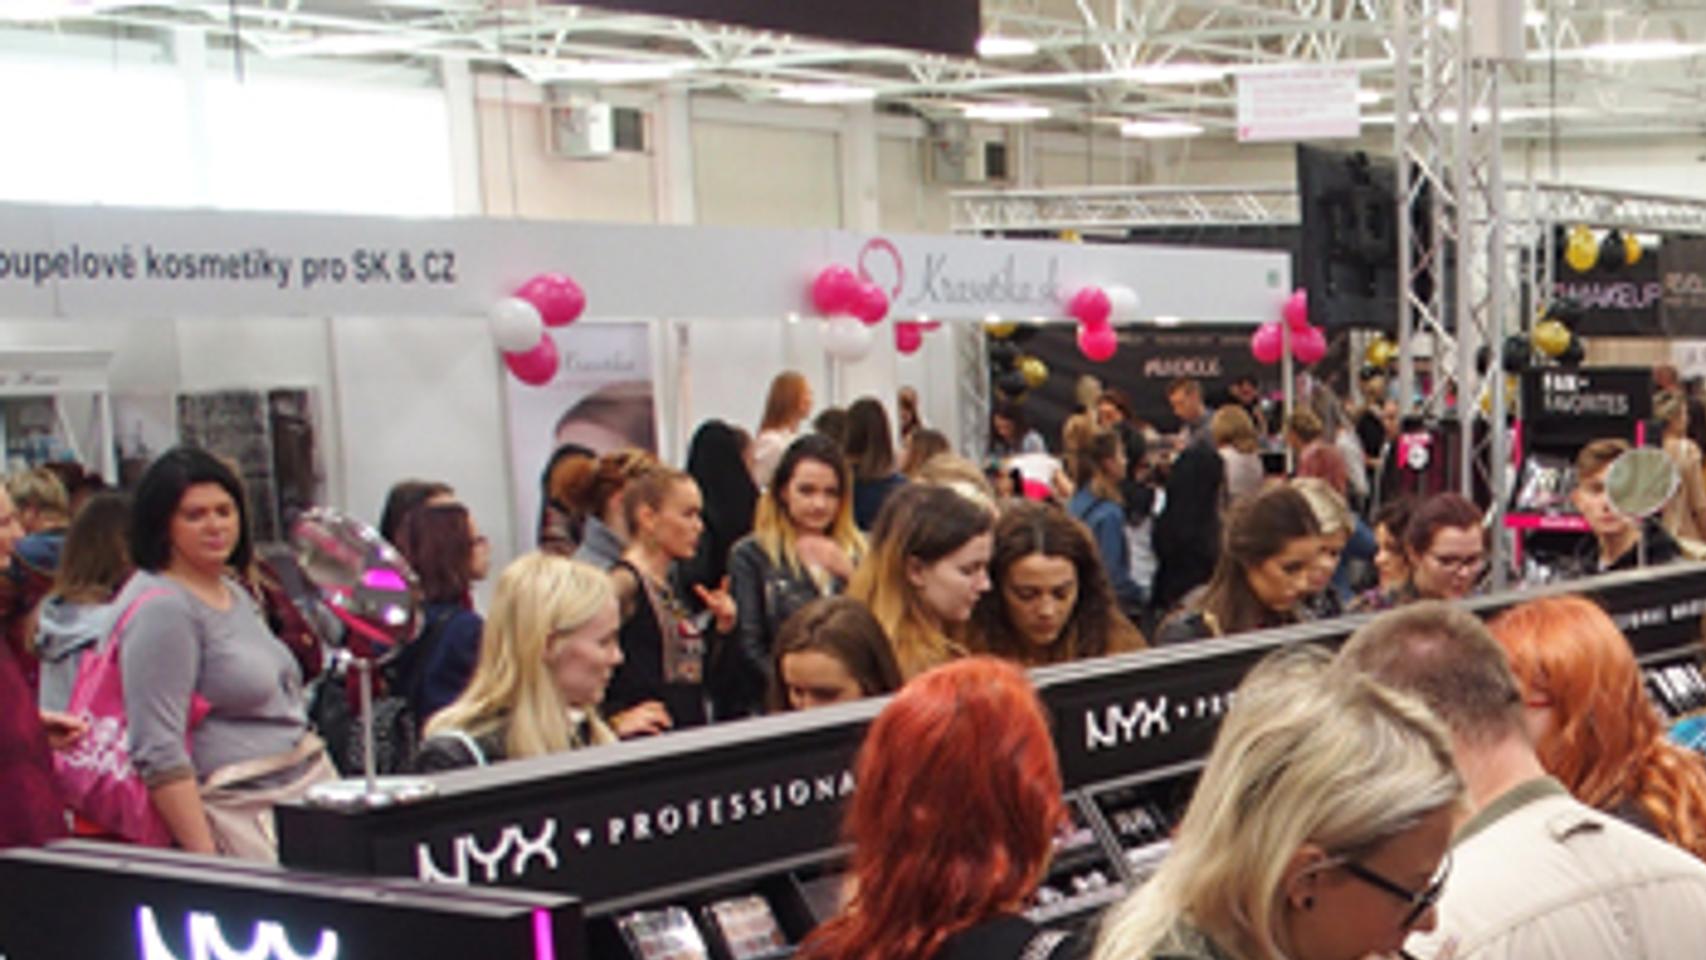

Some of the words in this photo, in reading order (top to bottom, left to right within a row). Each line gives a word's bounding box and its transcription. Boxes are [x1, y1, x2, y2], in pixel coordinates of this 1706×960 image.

[145, 246, 292, 288] kosmetiky
[301, 253, 347, 288] pro
[354, 248, 390, 283] SK
[398, 251, 416, 283] &
[422, 250, 457, 284] CZ
[1085, 696, 1169, 749] NYX
[416, 818, 558, 886] NYX
[607, 769, 858, 846] PROFESSIONA
